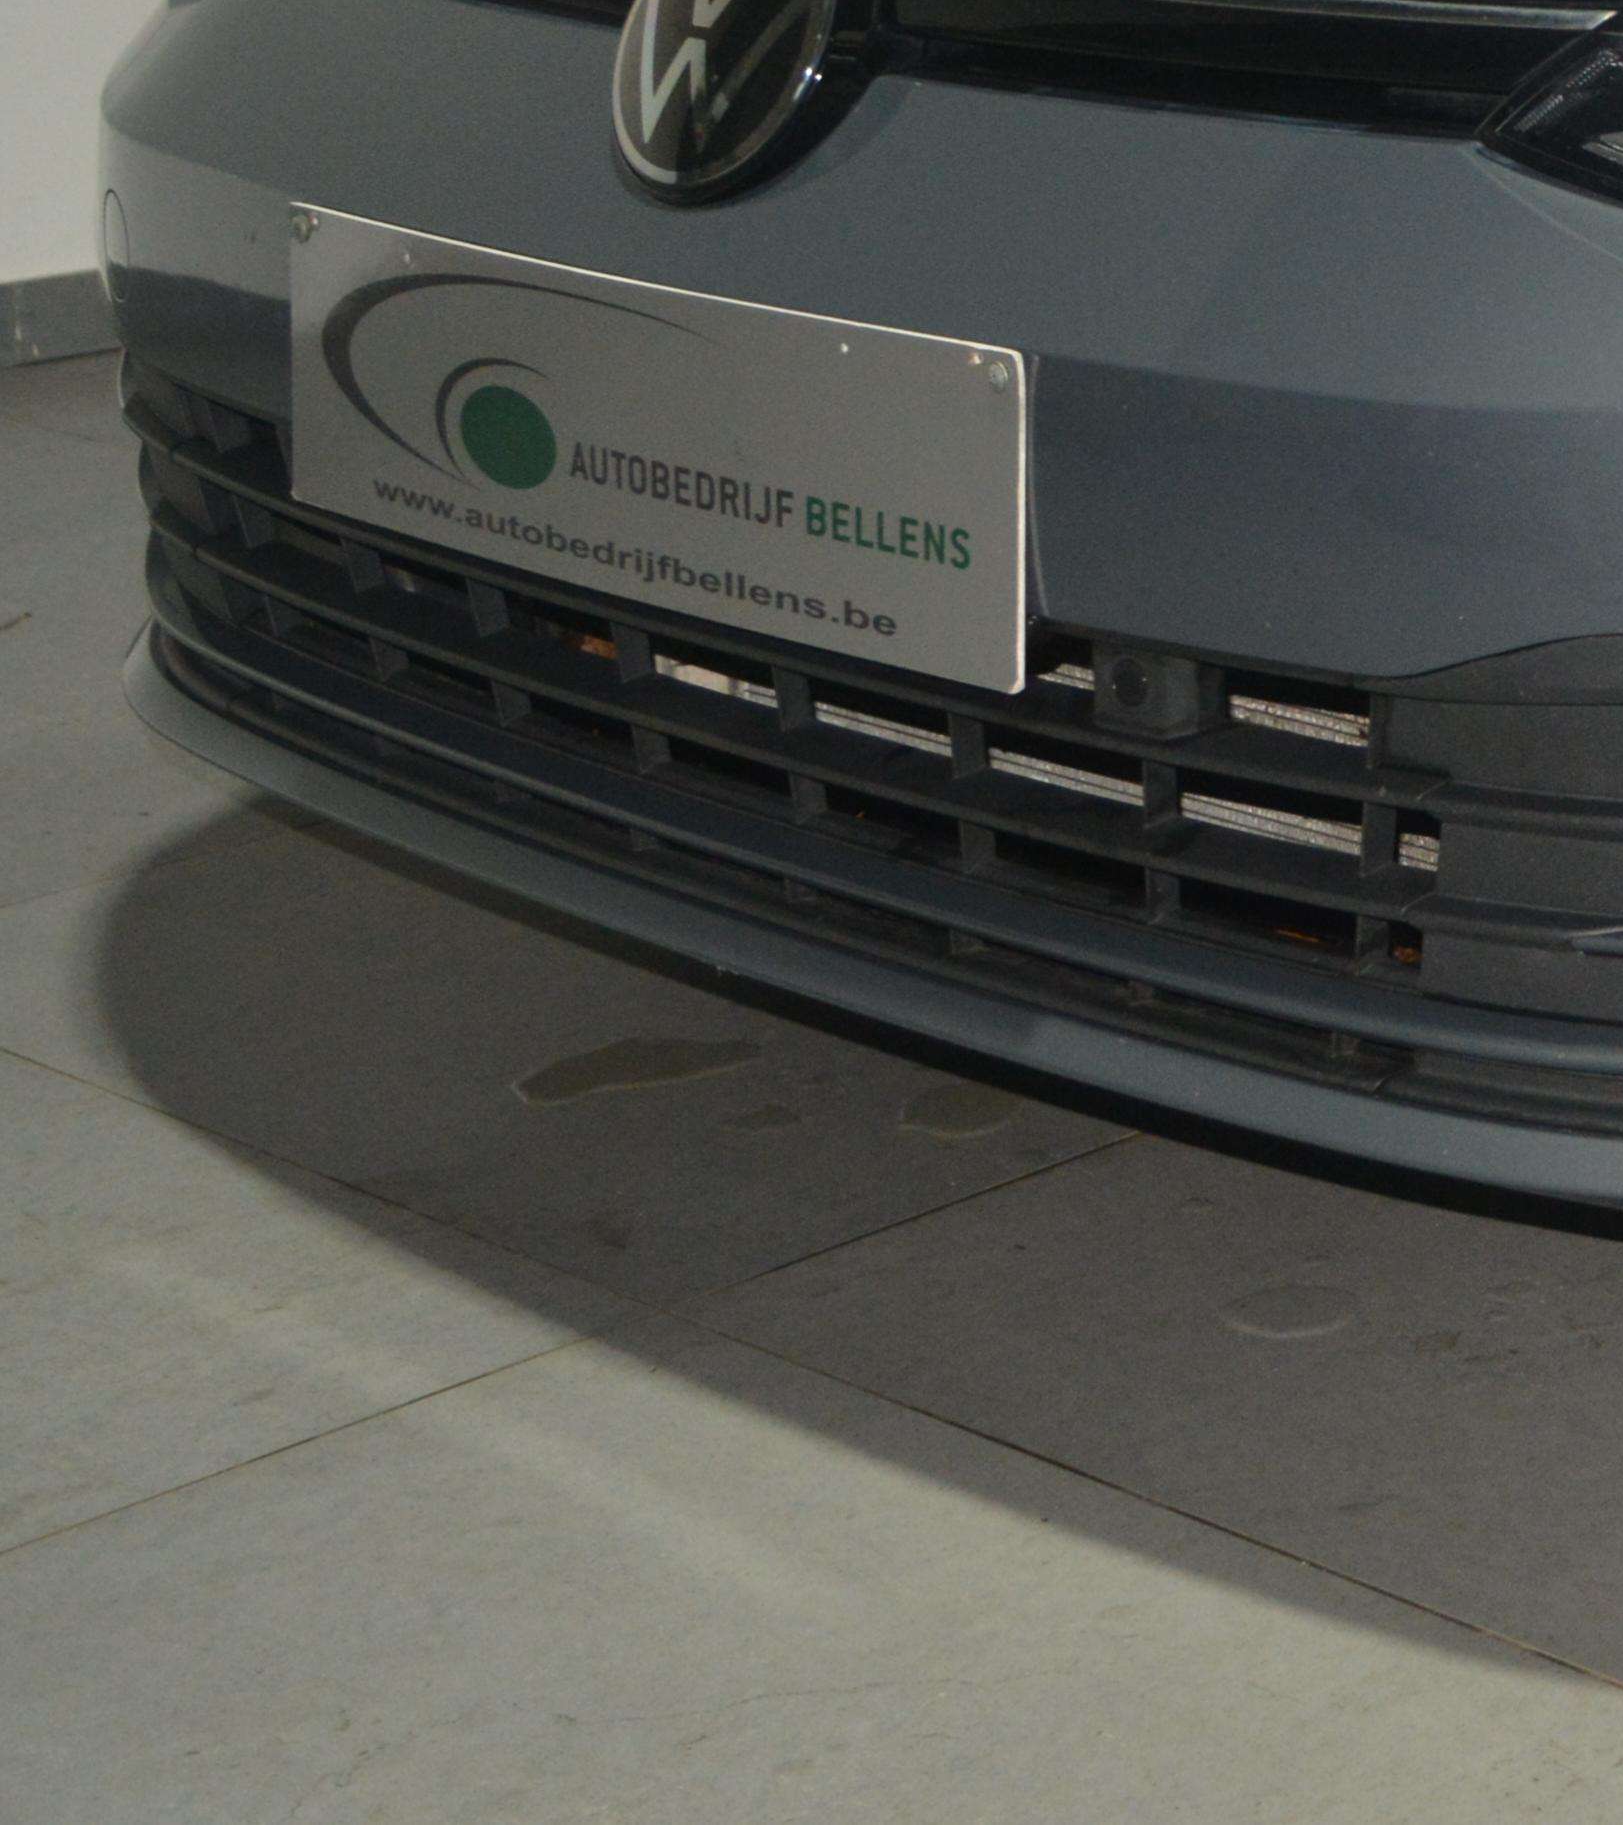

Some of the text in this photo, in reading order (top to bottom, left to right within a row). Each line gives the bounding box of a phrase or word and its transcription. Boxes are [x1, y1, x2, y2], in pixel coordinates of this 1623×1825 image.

[372, 477, 897, 638] www.autobedrijfbellens.be
[571, 441, 971, 571] AUTOBEDRIJF BELLENS
